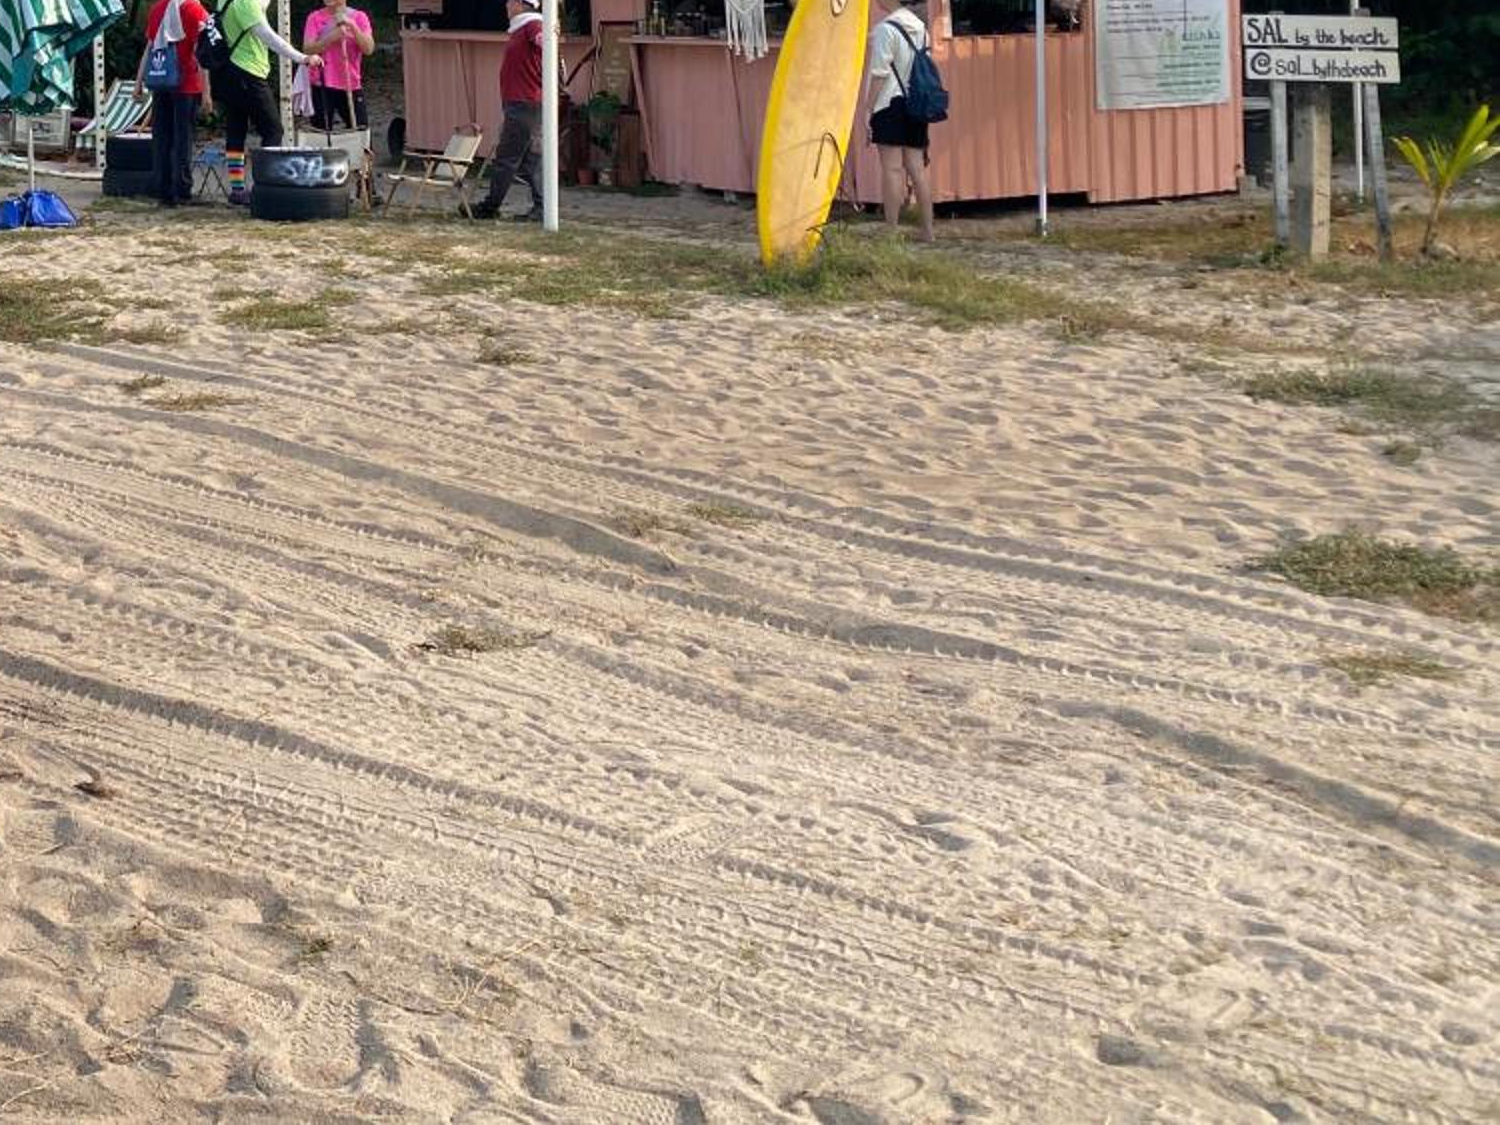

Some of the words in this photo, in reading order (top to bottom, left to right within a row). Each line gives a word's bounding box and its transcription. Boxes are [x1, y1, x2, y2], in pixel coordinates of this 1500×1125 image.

[1247, 17, 1288, 43] SAL
[1295, 28, 1310, 45] by
[1316, 28, 1336, 44] the
[1340, 27, 1390, 45] beach
